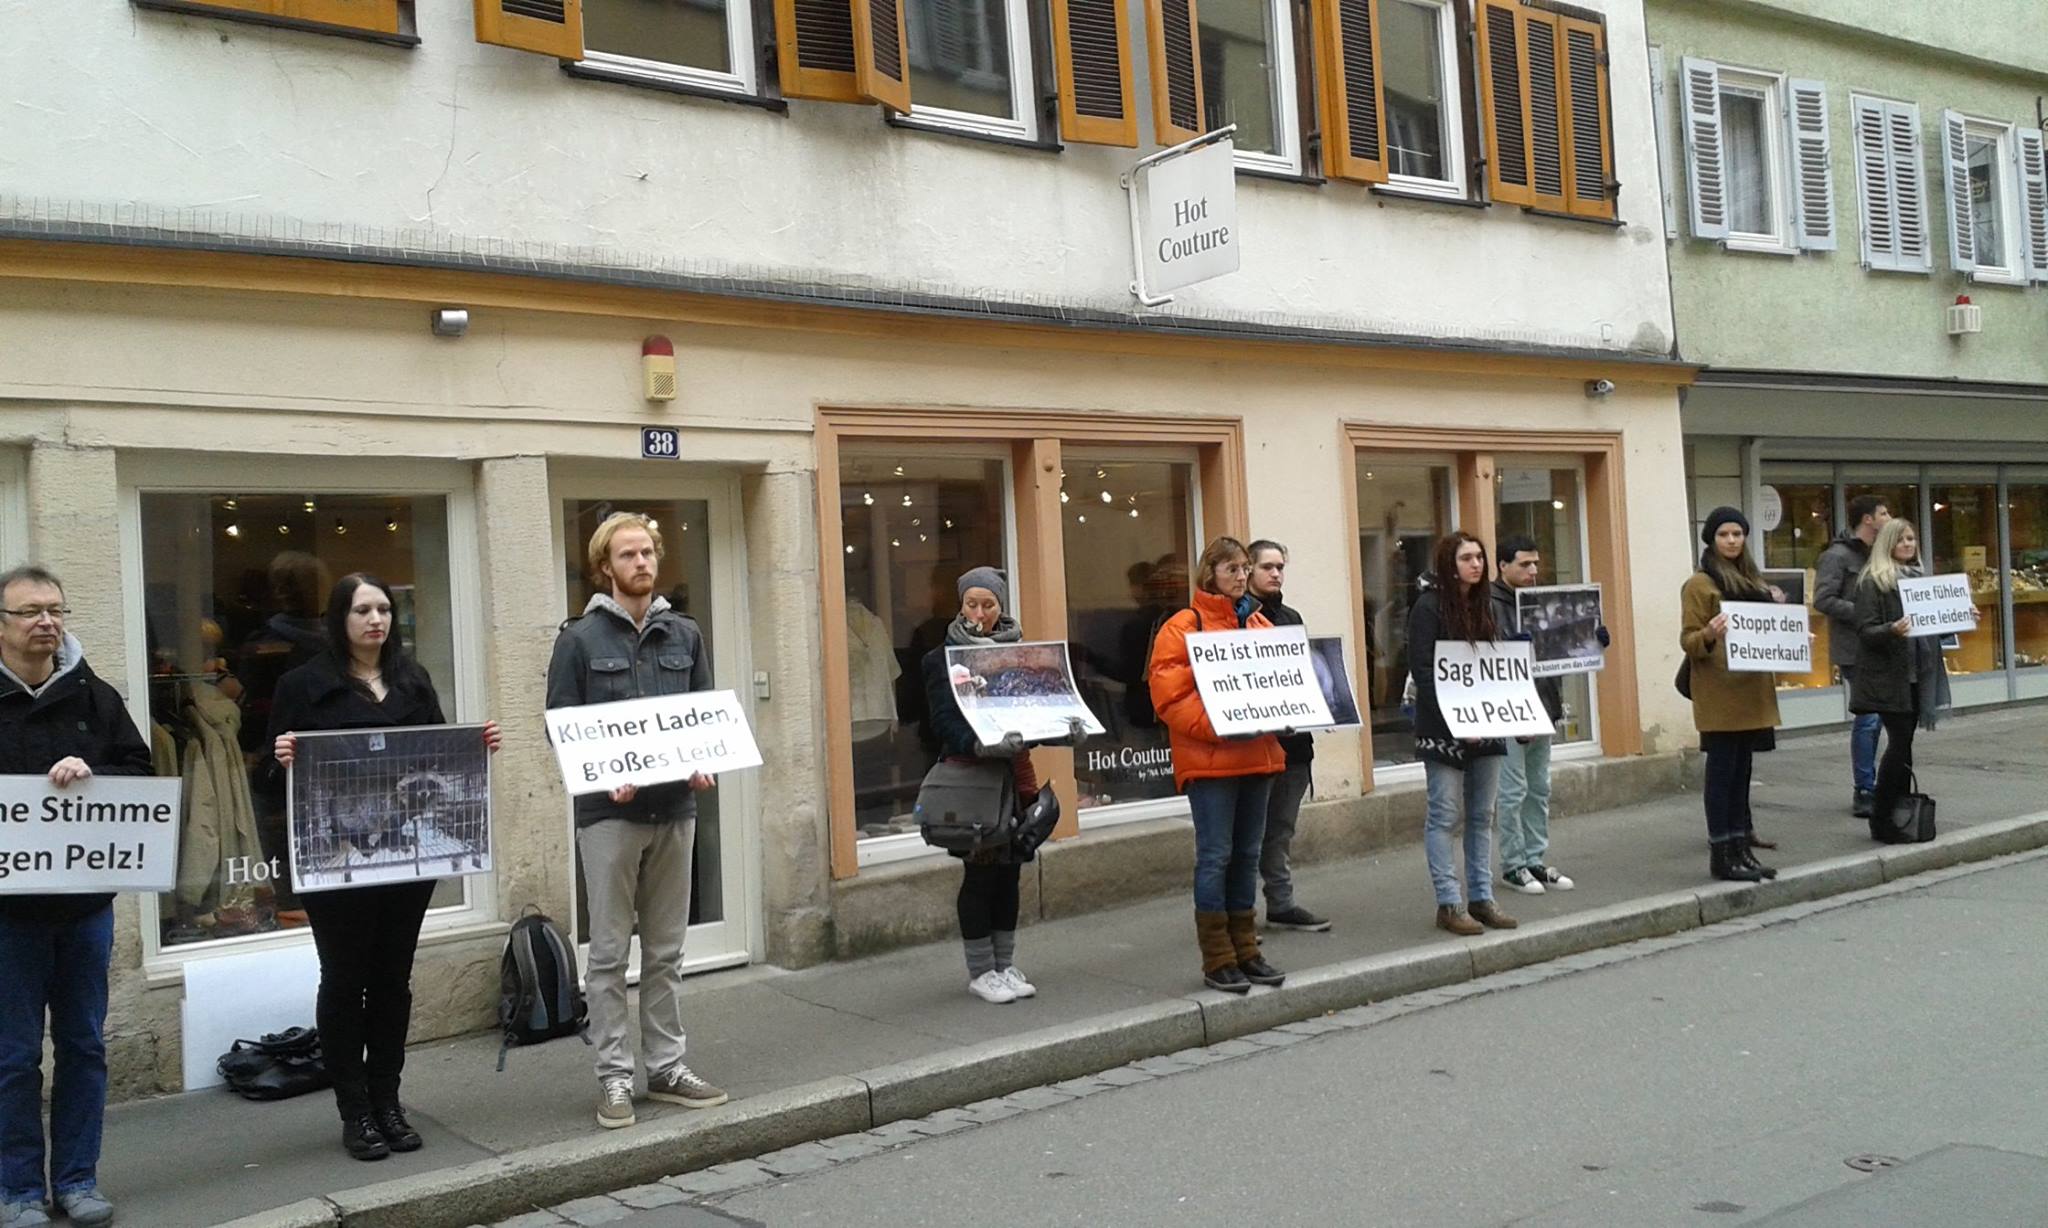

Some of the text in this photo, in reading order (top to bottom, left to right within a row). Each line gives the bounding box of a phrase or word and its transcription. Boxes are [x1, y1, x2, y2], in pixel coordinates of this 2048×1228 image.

[1174, 196, 1208, 227] Hot
[1159, 226, 1229, 263] Couture
[649, 431, 674, 455] 38
[1903, 584, 1969, 603] Tiere fühlen,
[1731, 613, 1803, 634] Stoppt den
[1909, 608, 1973, 627] Tiere leiden!
[1193, 640, 1305, 663] Pelz ist immer
[1730, 642, 1808, 662] Pelzverkauf!
[1213, 668, 1304, 693] mit Tierleid
[1438, 657, 1529, 687] Sag NEIN
[1223, 700, 1316, 722] verbunden.
[1453, 699, 1537, 724] zu Pelz!
[558, 707, 739, 744] Kleiner Laden,
[583, 740, 736, 782] großes Leid.
[1088, 746, 1172, 771] Hot Coutur
[40, 796, 171, 823] Stimme
[66, 843, 144, 870] Pelz!
[225, 855, 281, 885] Hot
